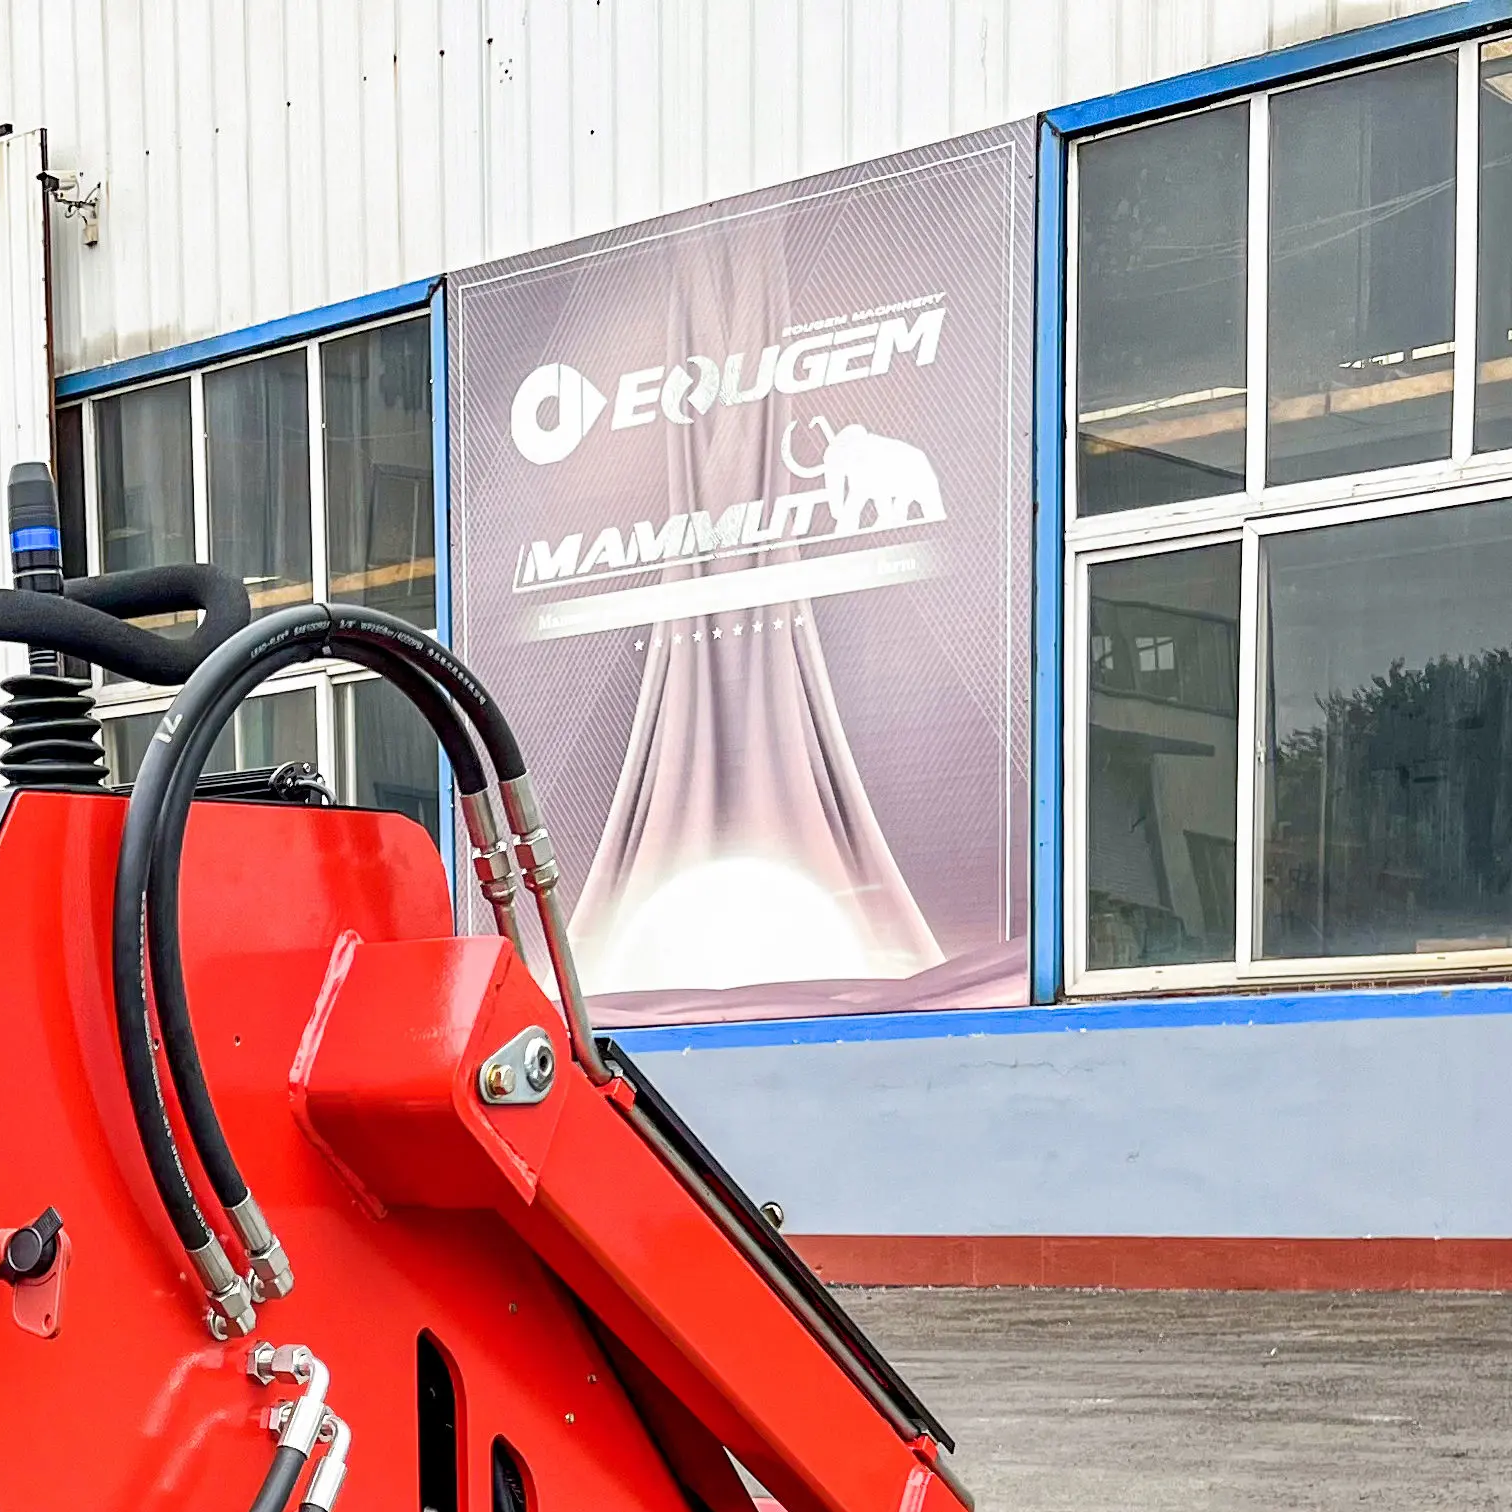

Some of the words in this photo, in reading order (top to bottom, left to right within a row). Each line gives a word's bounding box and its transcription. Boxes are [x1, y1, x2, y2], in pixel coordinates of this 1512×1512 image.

[851, 291, 947, 322] MACHINERY
[610, 307, 946, 432] EOUGEM
[520, 488, 835, 585] MAMMUT
